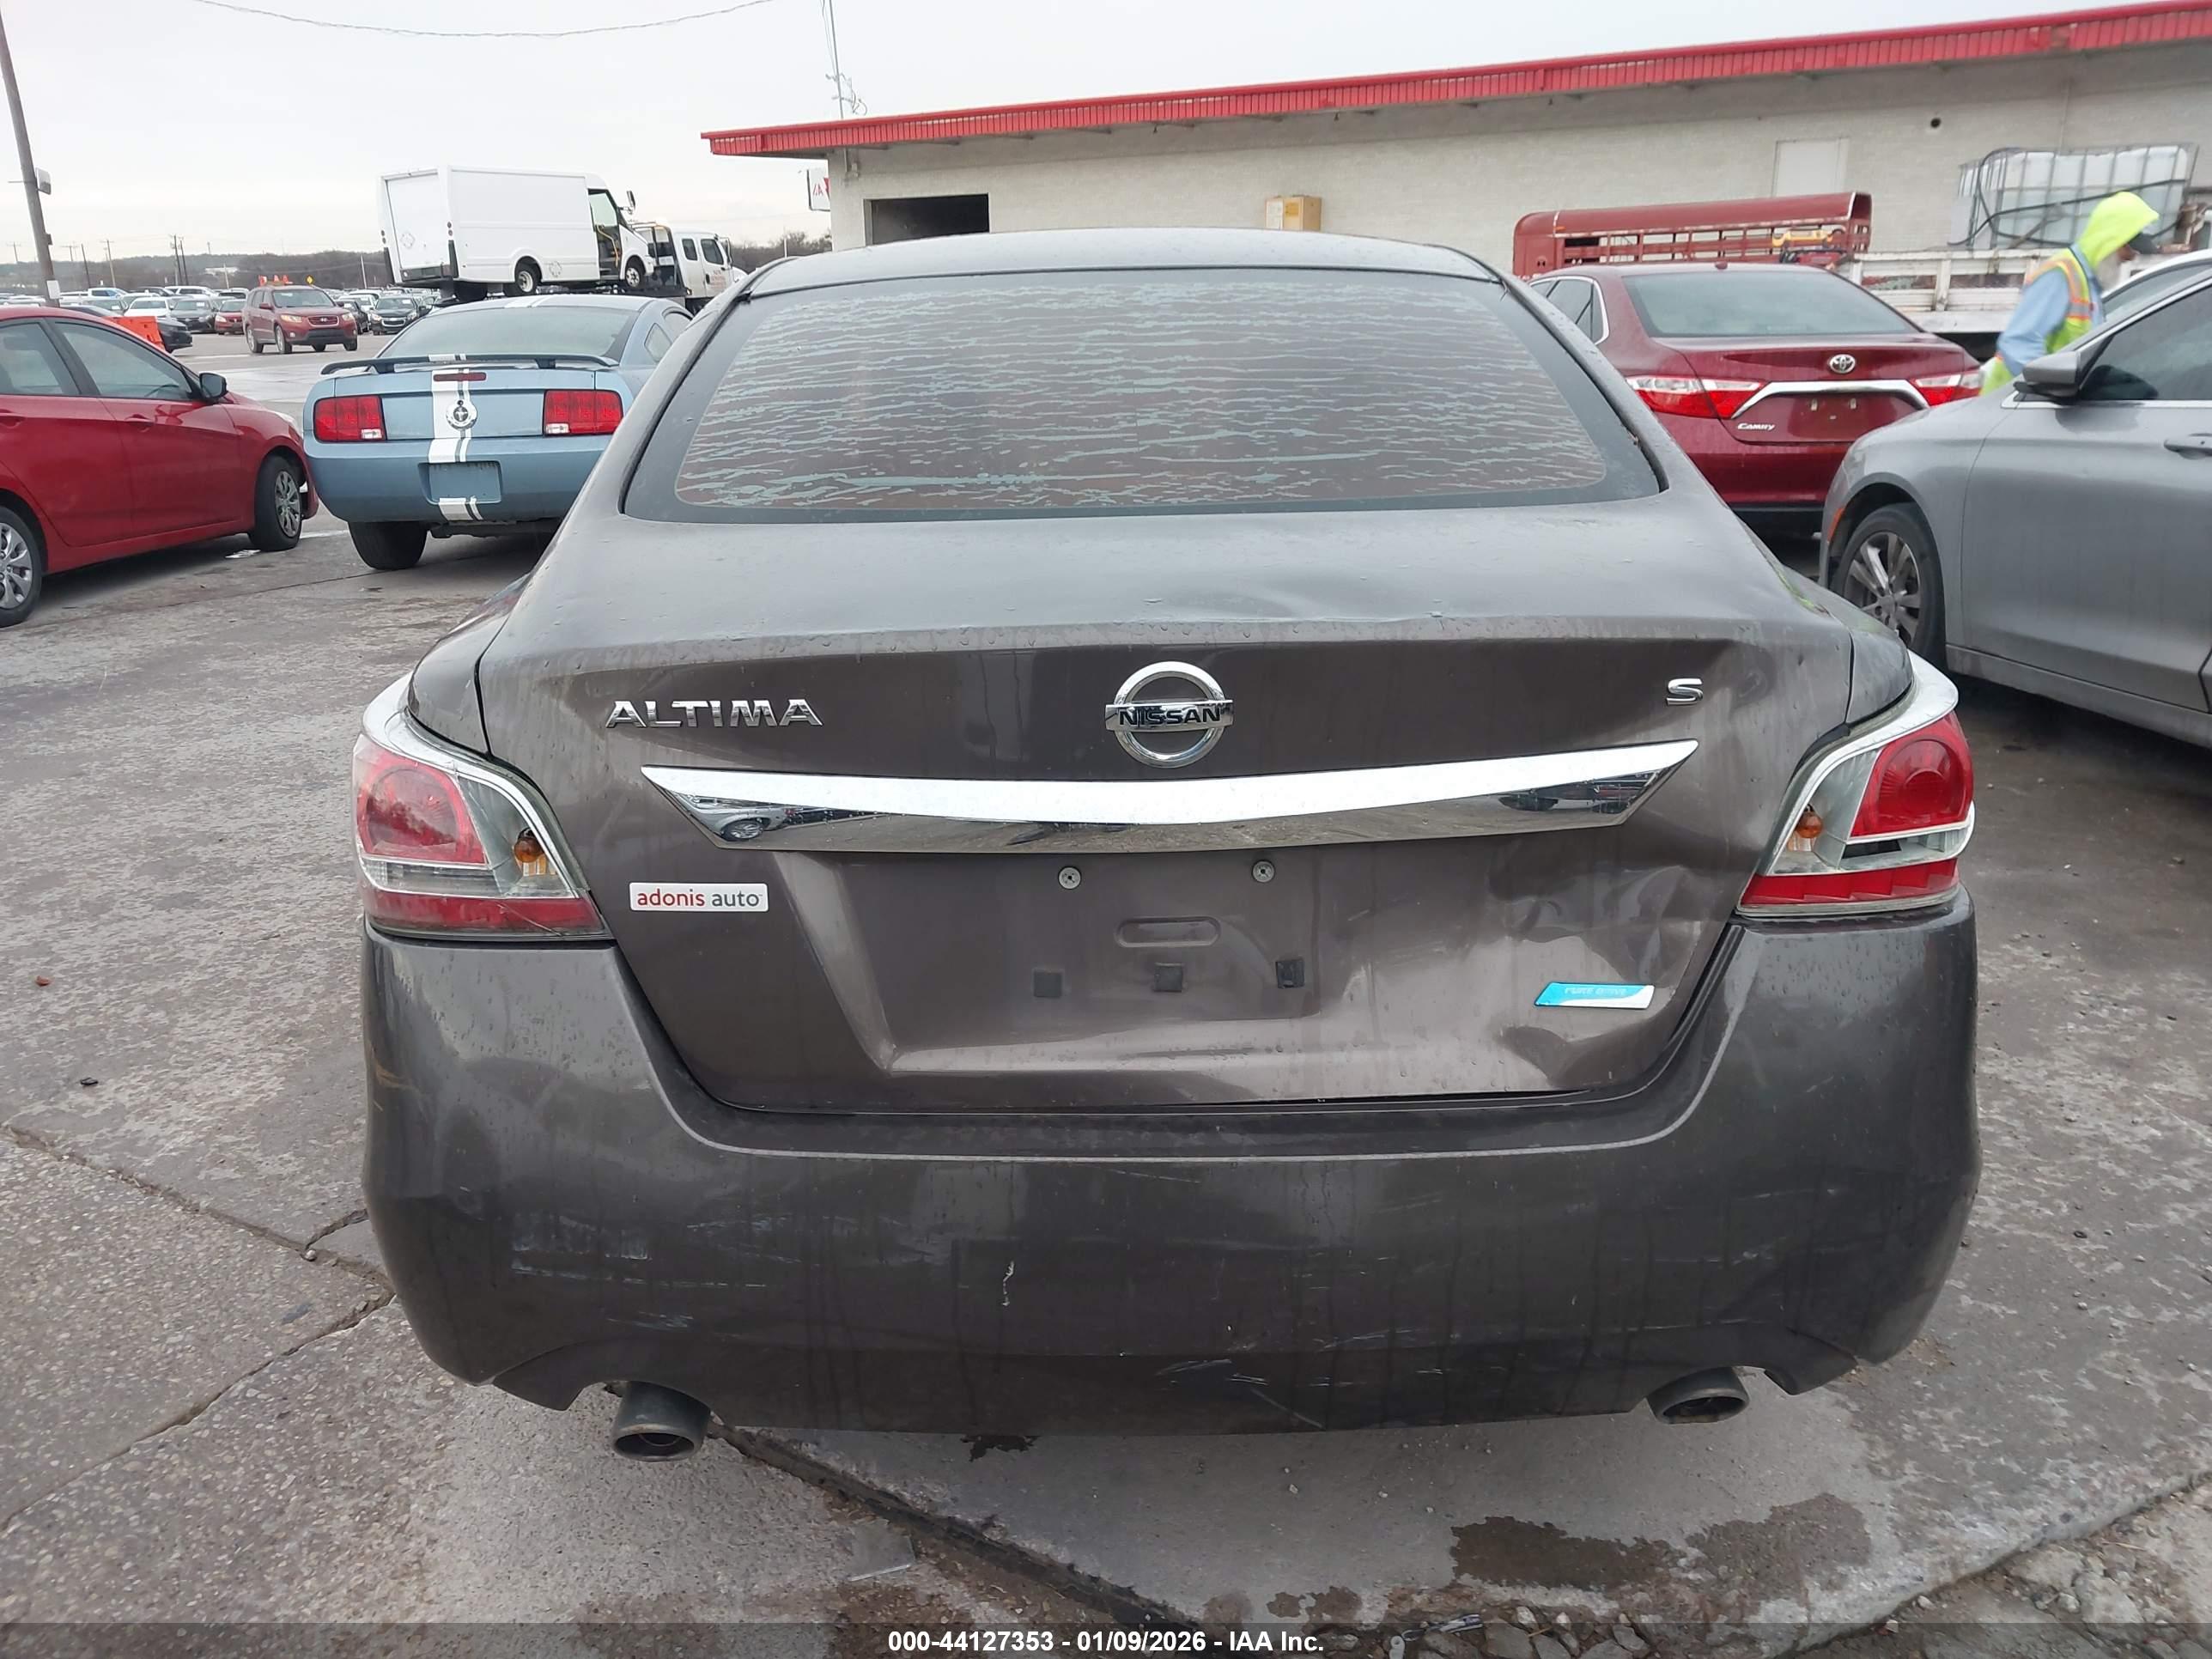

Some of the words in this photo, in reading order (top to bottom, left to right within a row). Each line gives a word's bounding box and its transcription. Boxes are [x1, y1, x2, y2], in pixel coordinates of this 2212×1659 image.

[1666, 678, 1704, 706] S
[605, 699, 823, 727] ALTIMA
[1118, 708, 1221, 726] NISSAN
[637, 888, 706, 907] adonis
